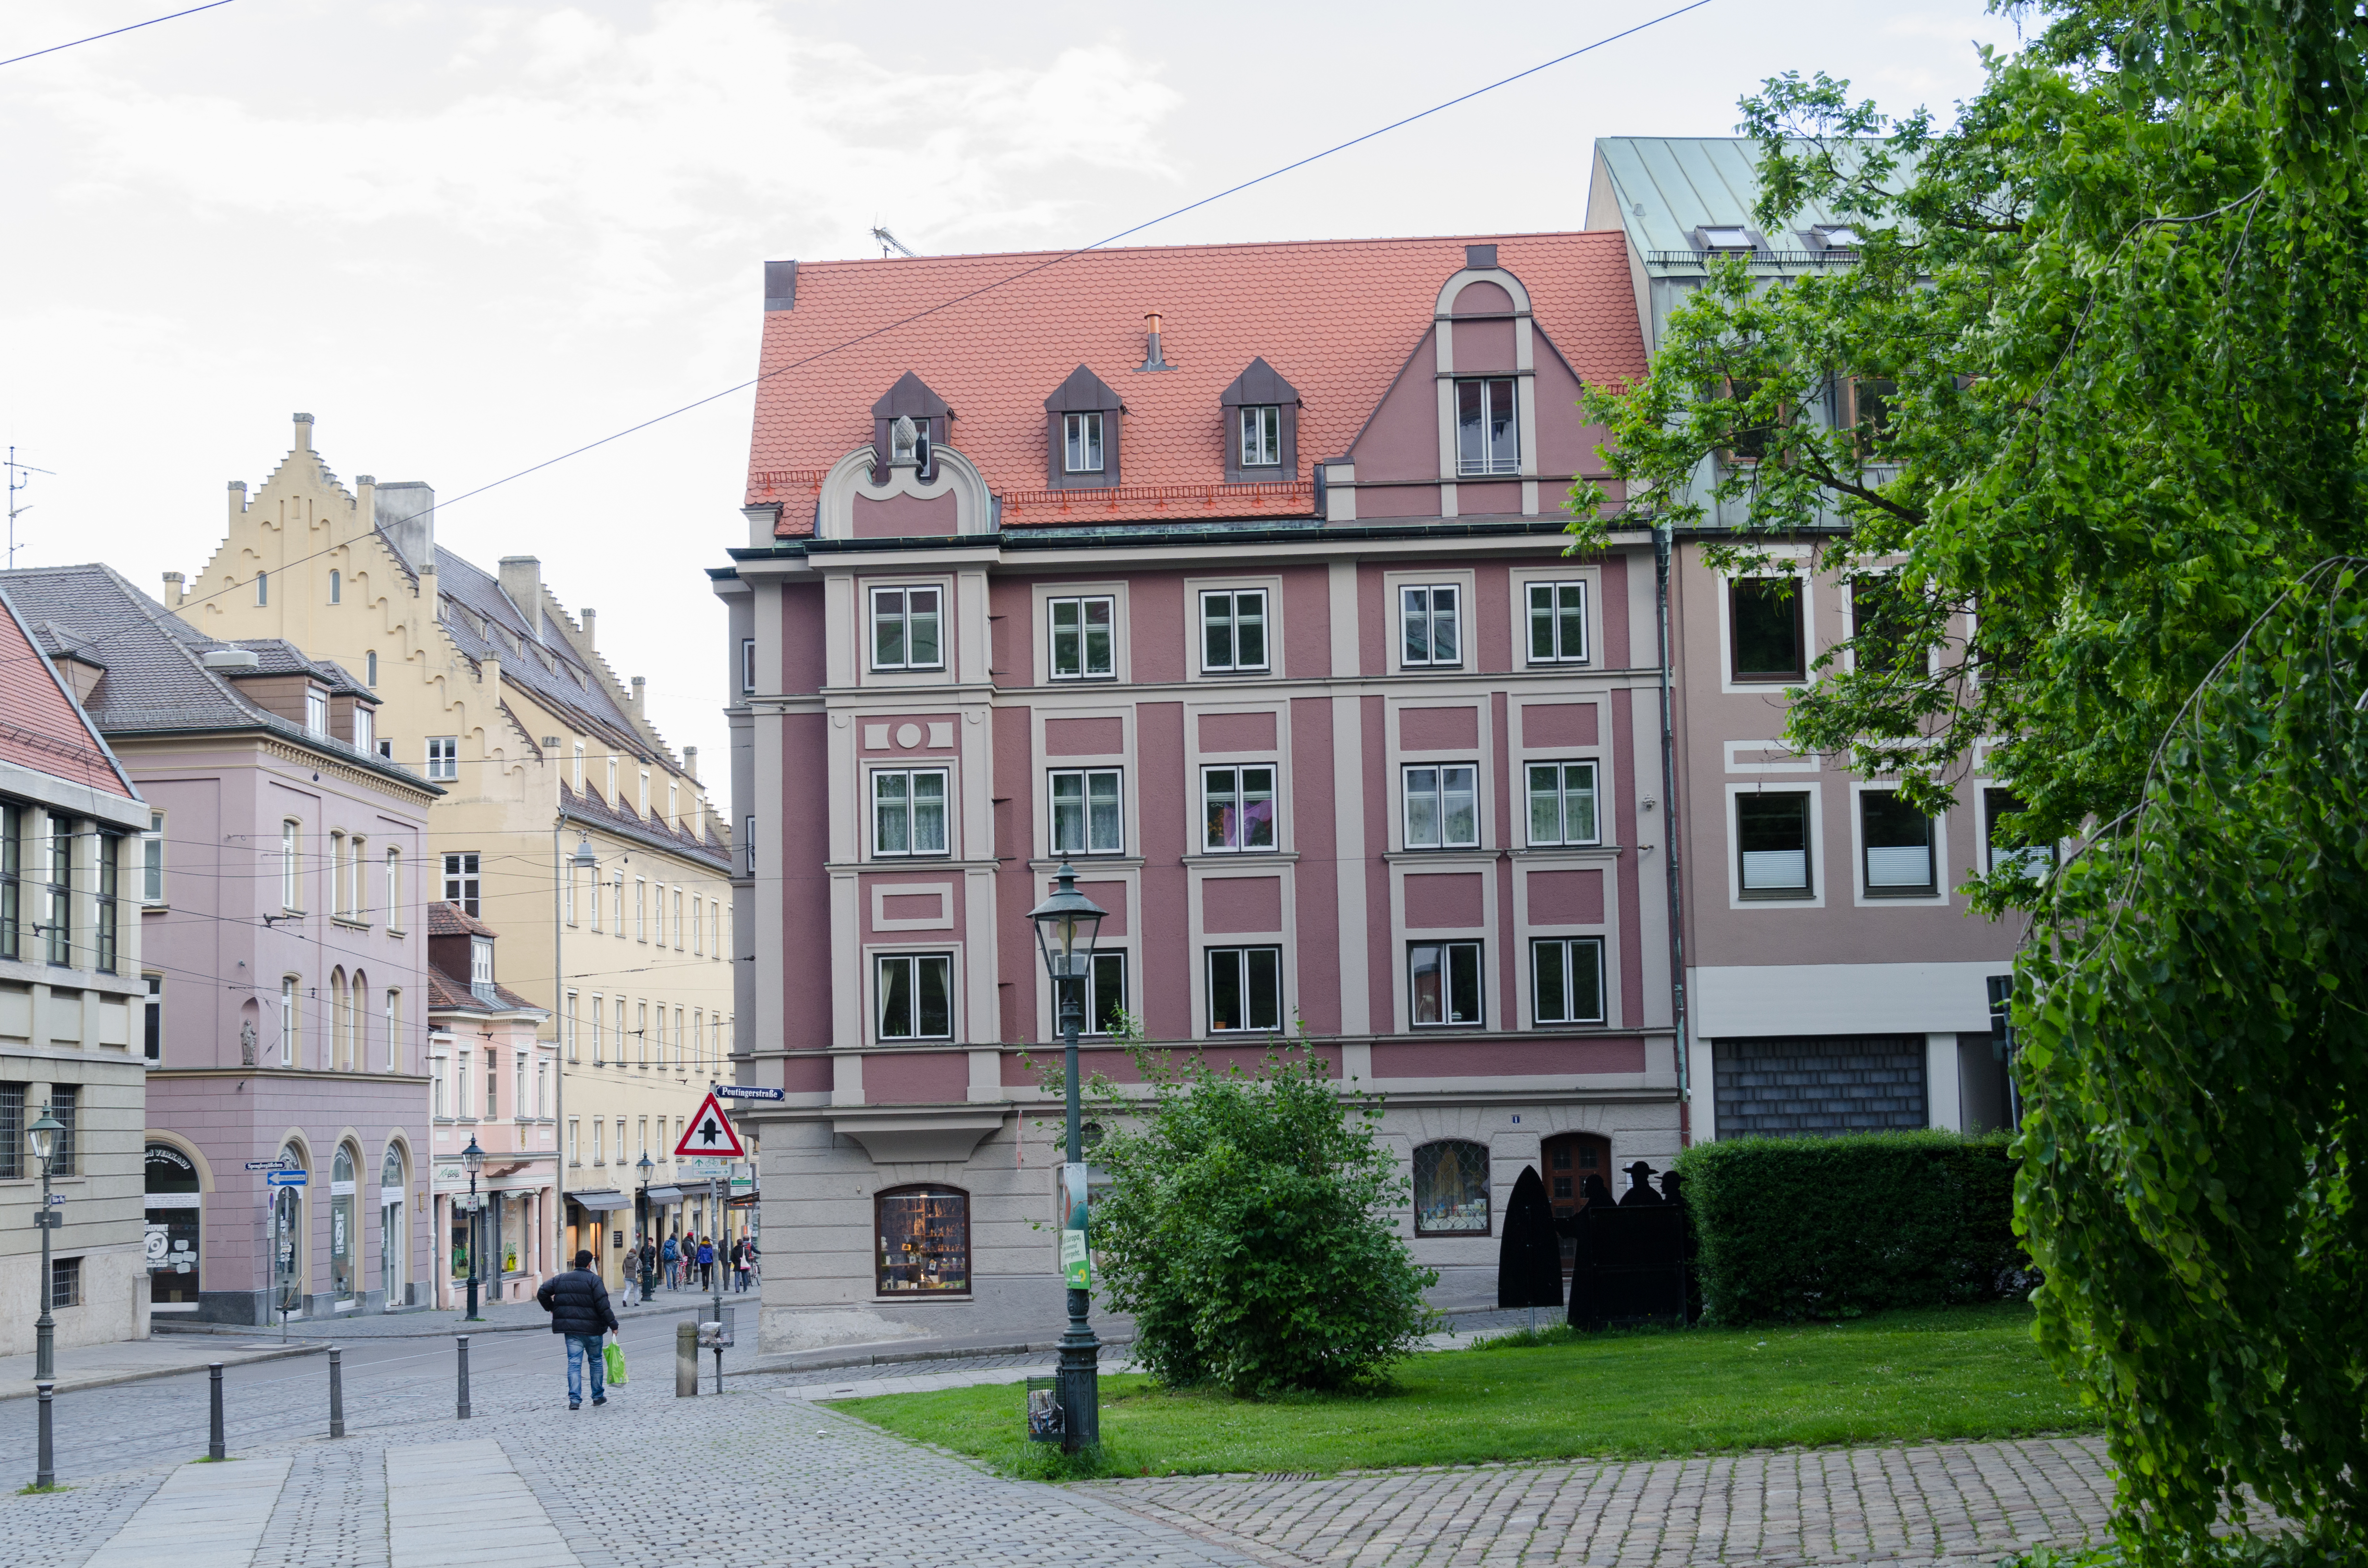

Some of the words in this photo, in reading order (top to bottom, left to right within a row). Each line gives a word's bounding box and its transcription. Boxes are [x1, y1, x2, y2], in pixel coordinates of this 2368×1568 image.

[722, 1087, 777, 1098] Peutingerstraße
[154, 1149, 191, 1170] VERKAUF
[1066, 1234, 1081, 1243] Europa,
